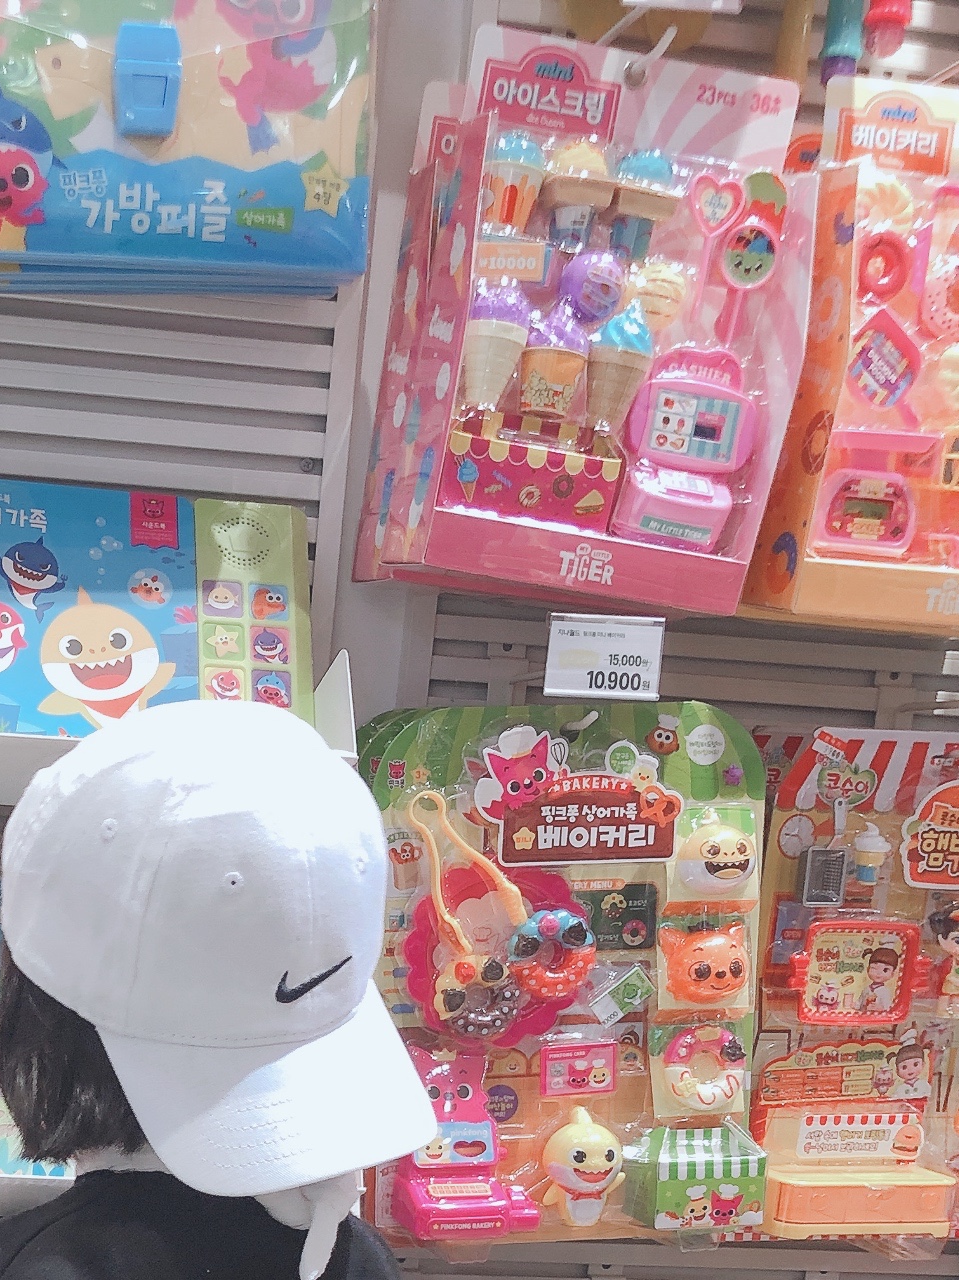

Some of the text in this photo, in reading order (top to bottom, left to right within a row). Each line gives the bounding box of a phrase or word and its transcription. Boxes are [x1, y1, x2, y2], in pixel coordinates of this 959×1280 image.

[534, 60, 575, 82] mini
[851, 123, 939, 158] 베이커리
[59, 168, 107, 200] 핑크퐁
[81, 179, 232, 242] 가방퍼즐
[242, 210, 286, 229] 상어가족
[559, 550, 615, 586] TIGER
[586, 670, 651, 691] 10,900원
[562, 776, 619, 792] BAKERY
[540, 802, 638, 823] 핑크퐁 상어가족
[536, 823, 655, 849] 베이커리
[440, 1221, 495, 1231] PINKFONG BAKERY
